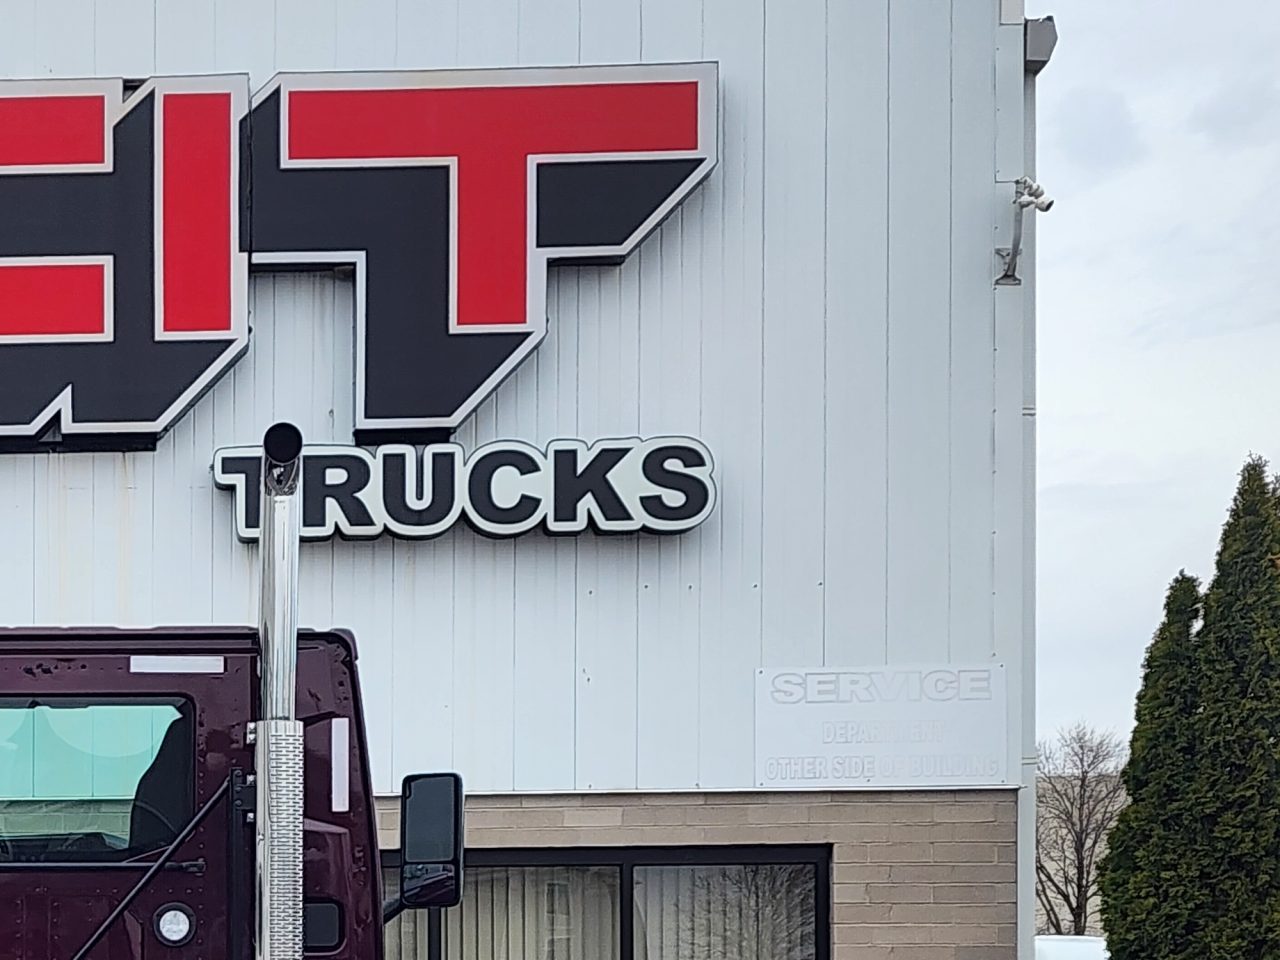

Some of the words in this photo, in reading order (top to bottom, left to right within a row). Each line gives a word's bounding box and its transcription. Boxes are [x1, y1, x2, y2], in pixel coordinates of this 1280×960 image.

[221, 445, 710, 528] TRUCKS
[771, 670, 992, 704] SERVICE
[822, 720, 944, 744] DEPARENT
[766, 757, 828, 780] OTHER
[831, 755, 875, 779] SIDE
[910, 754, 999, 778] BUILDING
